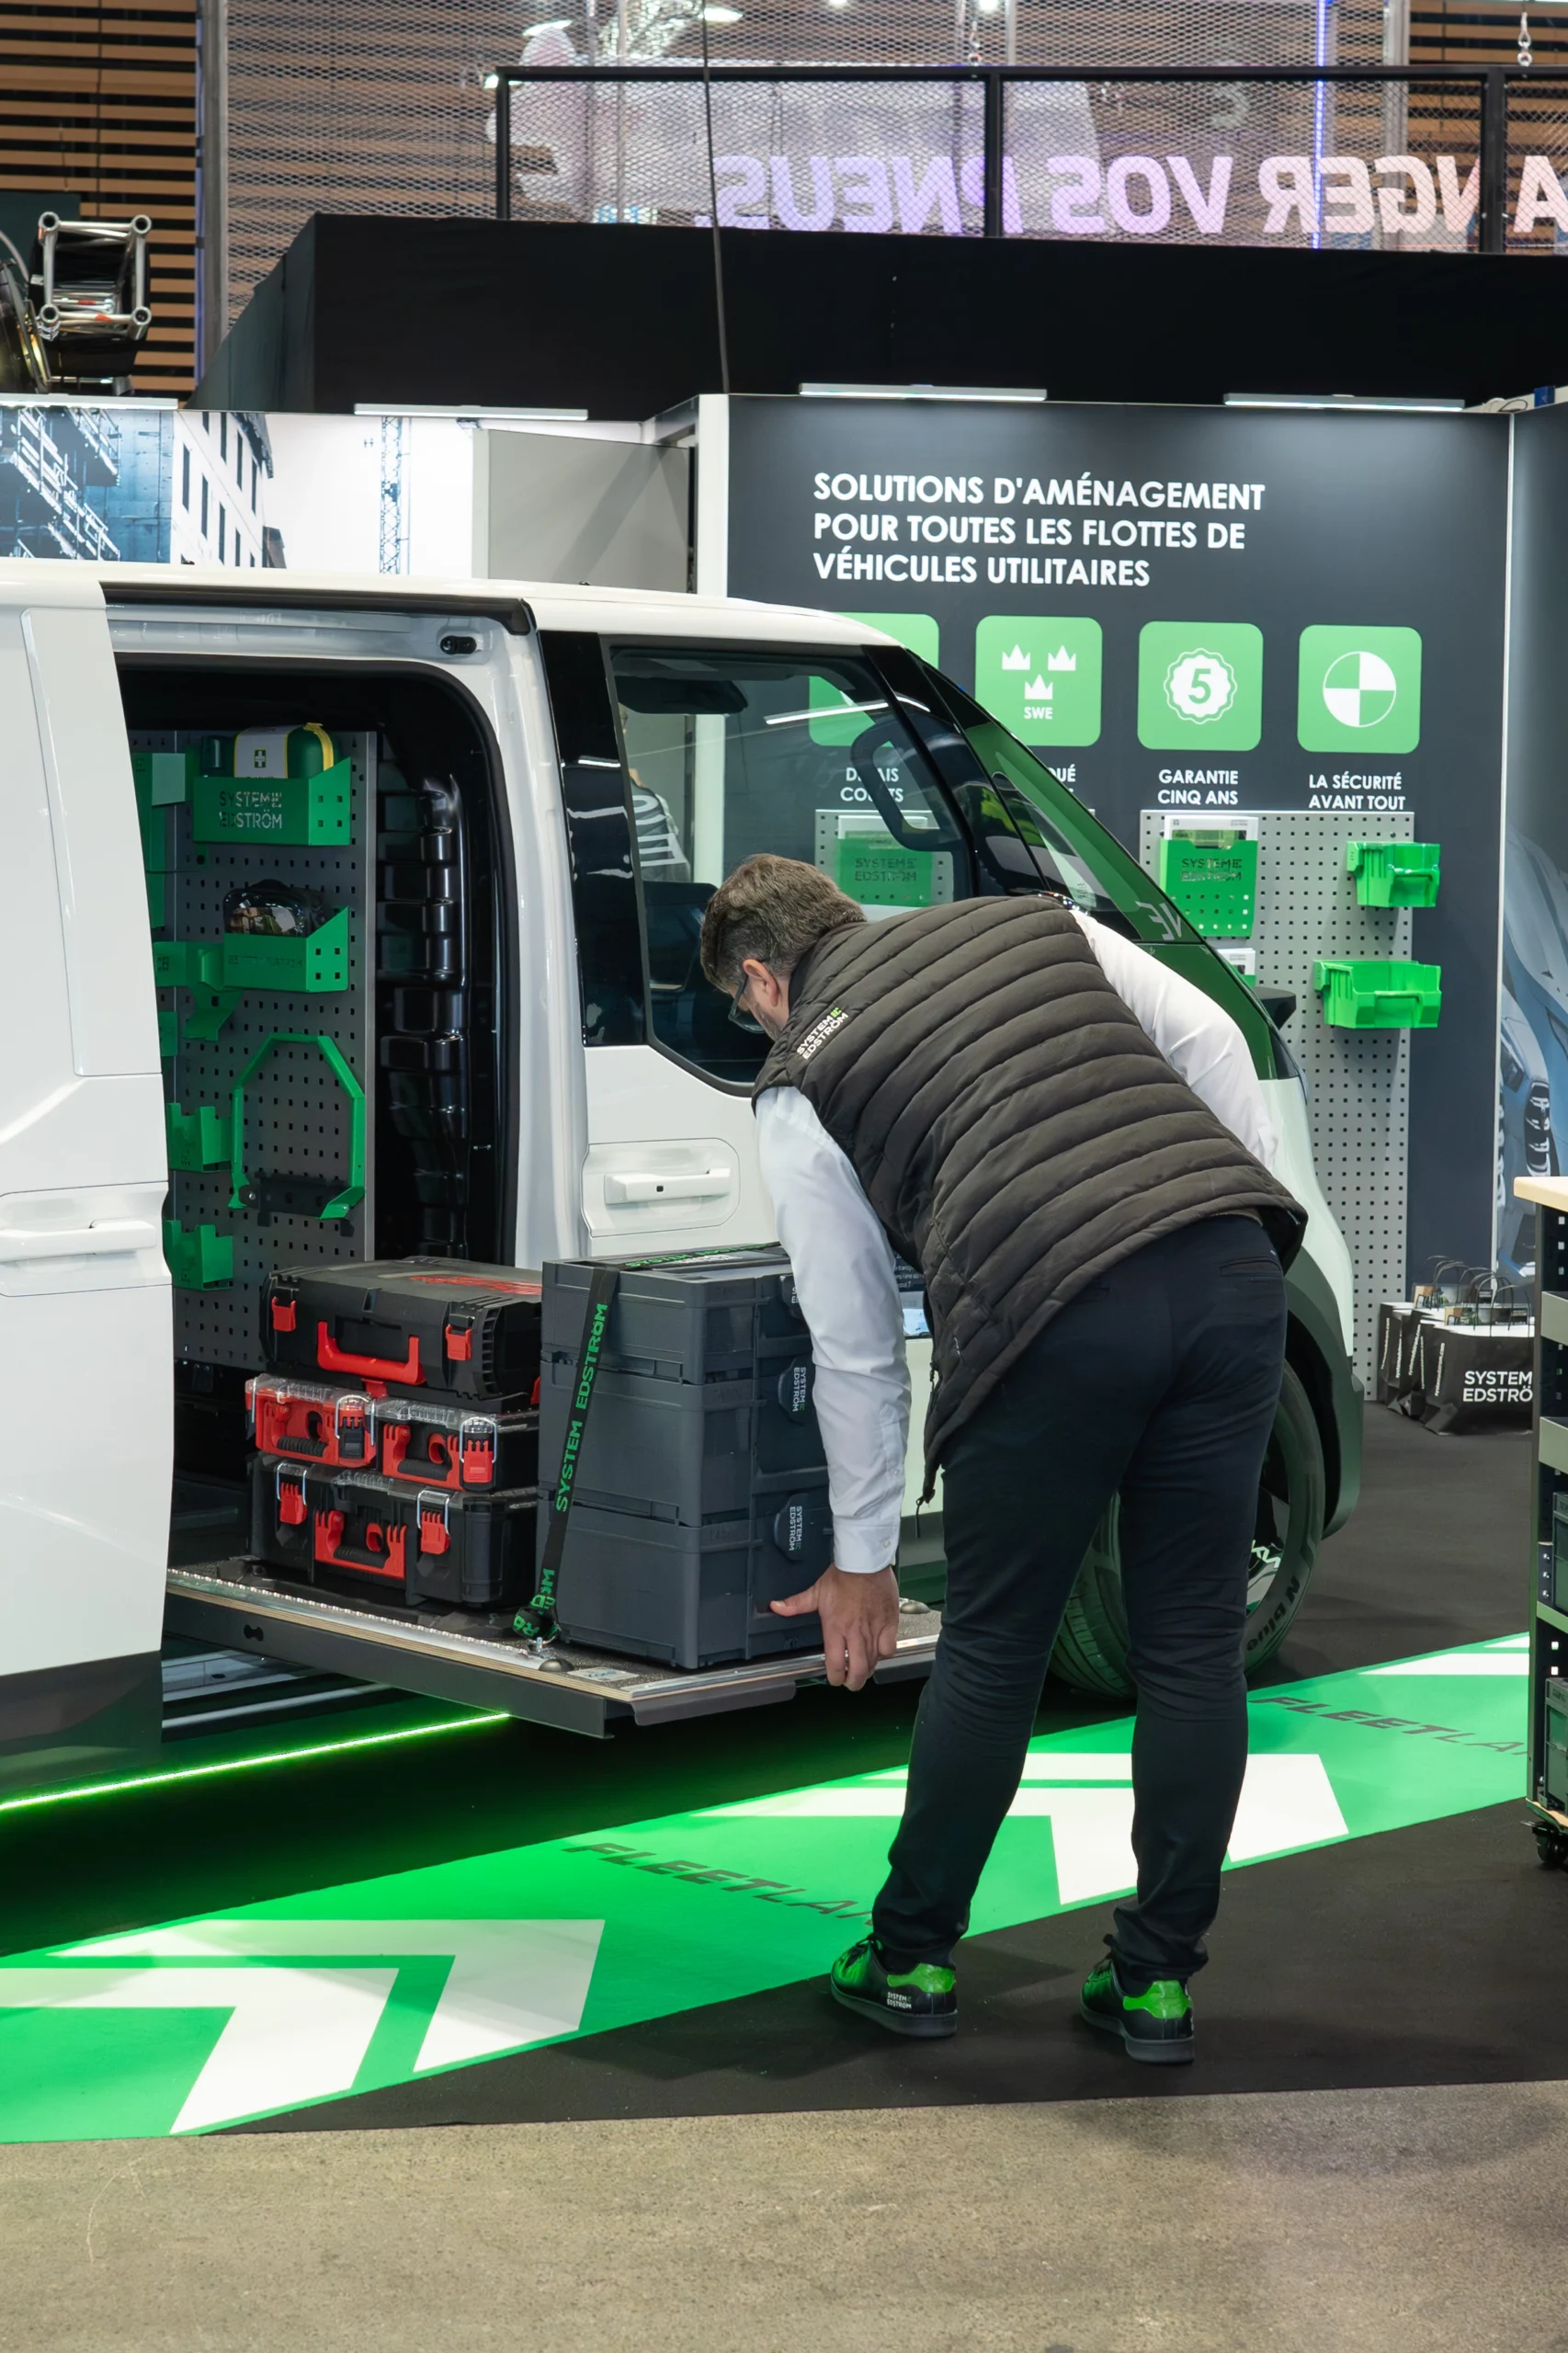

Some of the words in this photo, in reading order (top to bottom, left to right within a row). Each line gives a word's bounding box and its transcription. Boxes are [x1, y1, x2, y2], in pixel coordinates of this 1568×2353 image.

[813, 472, 984, 504] SOLUTIONS
[994, 472, 1266, 511] D'AMÉNAGEMENT
[813, 513, 899, 542] POUR
[907, 516, 1017, 545] TOUTES
[1026, 517, 1073, 546] LES
[1083, 519, 1197, 550] FLOTTES
[1207, 523, 1245, 550] DE
[813, 545, 978, 584] VÉHICULES
[987, 556, 1151, 587] UTILITAIRES
[1187, 667, 1212, 705] 5
[1023, 706, 1054, 721] SWE
[1158, 768, 1239, 785] GARANTIE
[1309, 774, 1325, 790] LA
[1332, 770, 1403, 790] SÉCURITÉ
[1157, 789, 1201, 805] CINQ
[1205, 790, 1239, 805] ANS
[1308, 794, 1364, 810] AVANT
[1368, 795, 1406, 811] TOUT
[796, 1015, 834, 1055] SYSTEM
[801, 1012, 849, 1060] EDSTRÖM
[792, 1367, 801, 1412] EDSTRÖM
[1464, 1370, 1533, 1385] SYSTEM
[556, 1419, 584, 1513] SYSTEM
[574, 1302, 608, 1410] EDSTRÖM
[789, 1506, 797, 1552] EDSTRÖM
[1247, 1696, 1528, 1756] FLEETLA
[887, 1992, 907, 2002] SYSTEM
